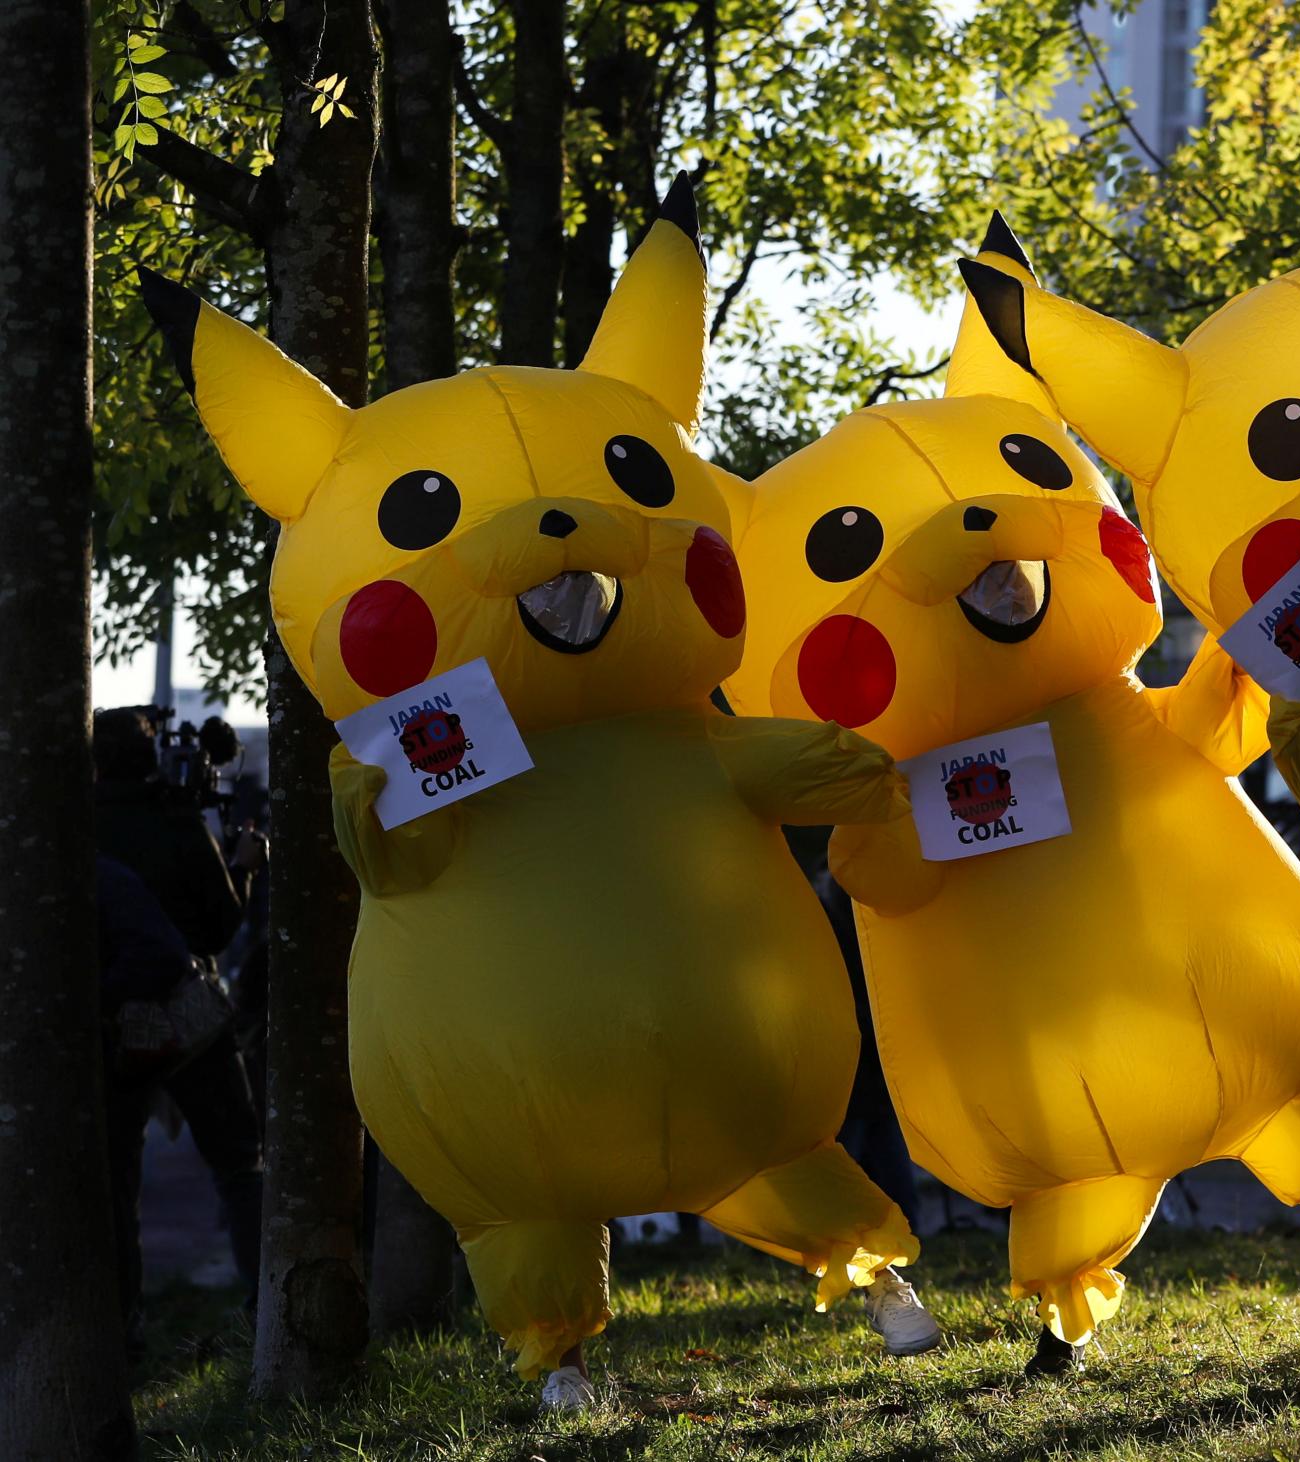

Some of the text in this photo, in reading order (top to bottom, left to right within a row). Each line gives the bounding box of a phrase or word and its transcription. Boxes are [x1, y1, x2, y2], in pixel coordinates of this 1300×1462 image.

[389, 692, 453, 735] JAPAN
[399, 713, 461, 755] STOP
[409, 738, 474, 773] FUNDING
[940, 748, 1007, 782] JAPAN
[421, 760, 485, 797] COAL
[945, 769, 1011, 801] STOP
[950, 795, 1017, 821] FUNDING
[958, 816, 1024, 845] COAL
